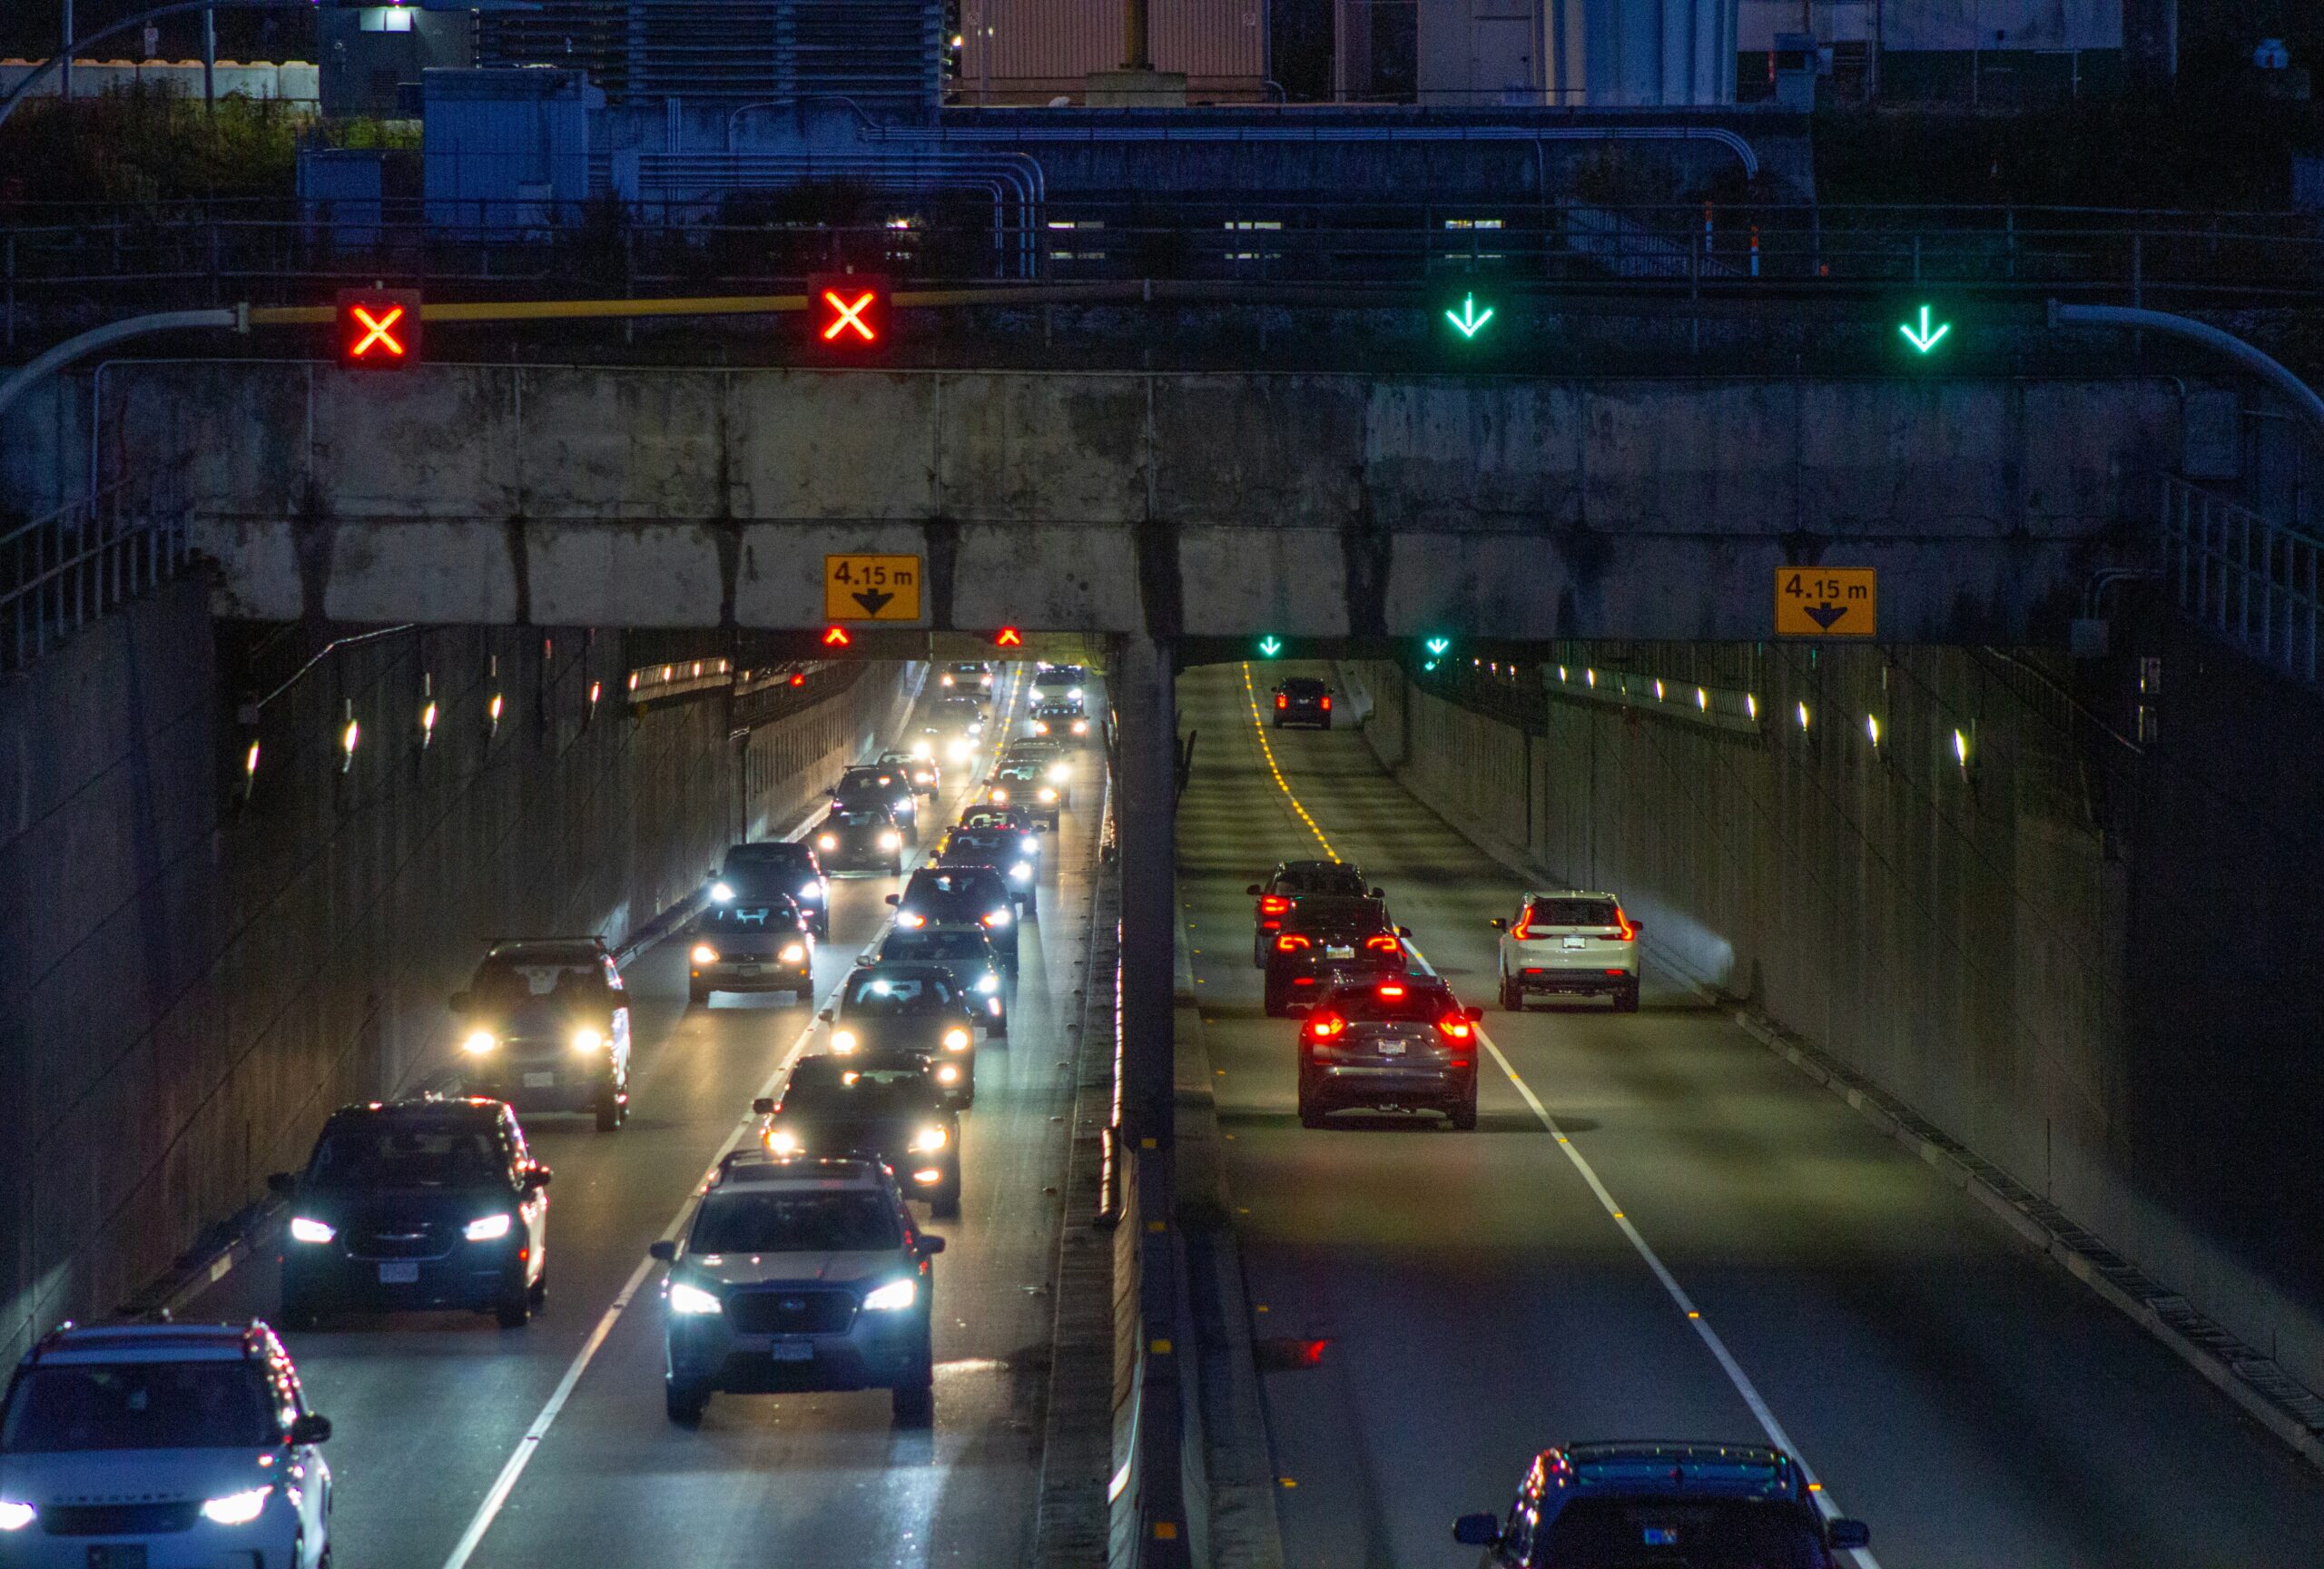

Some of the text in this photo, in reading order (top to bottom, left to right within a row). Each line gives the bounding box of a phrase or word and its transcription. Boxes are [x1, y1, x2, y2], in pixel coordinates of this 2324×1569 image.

[834, 560, 912, 586] 4.15 m
[1785, 573, 1867, 599] 4.15 m
